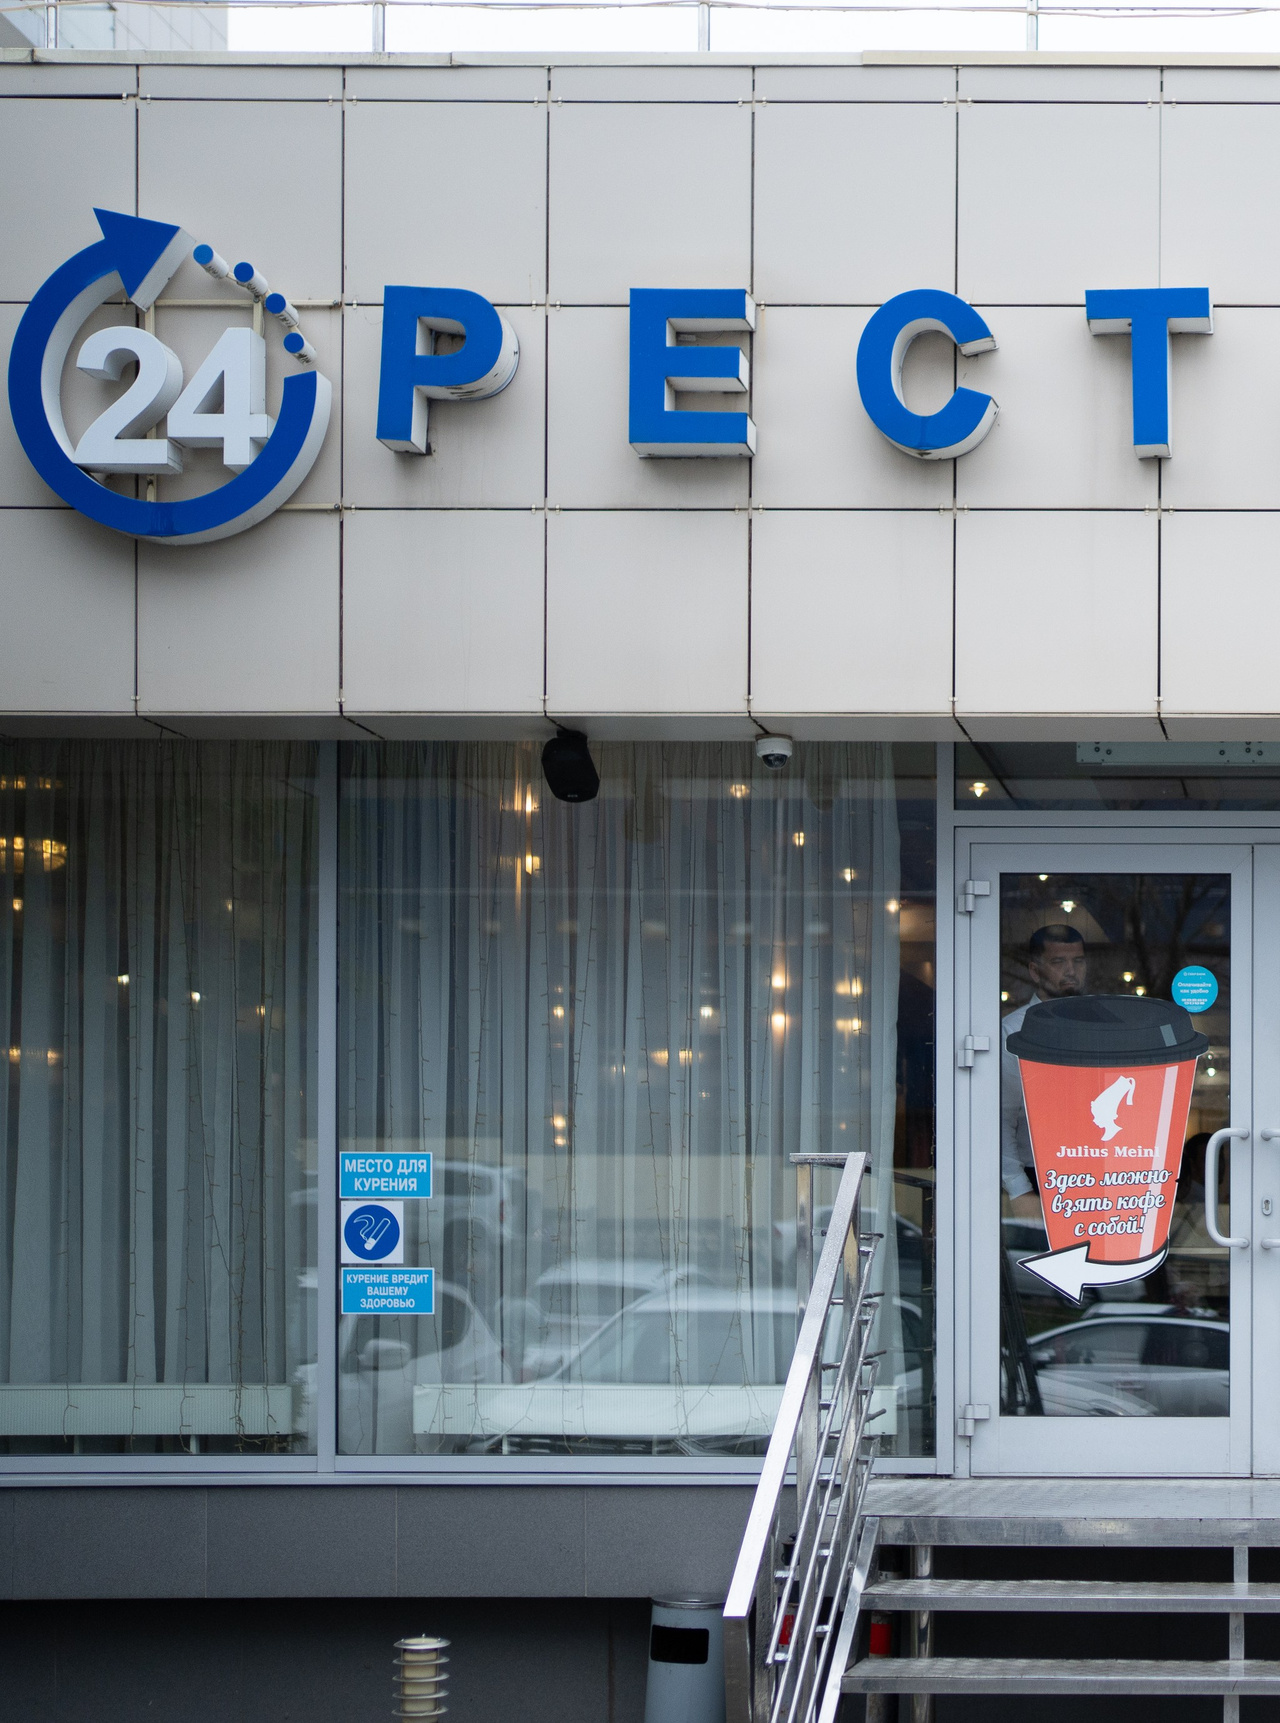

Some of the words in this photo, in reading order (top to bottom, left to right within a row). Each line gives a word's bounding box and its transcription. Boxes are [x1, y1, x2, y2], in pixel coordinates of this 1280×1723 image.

[74, 326, 272, 470] 24
[1056, 1145, 1109, 1158] Julius
[1114, 1145, 1160, 1158] Meinl
[345, 1159, 393, 1173] МЕСТО
[397, 1159, 427, 1175] ДЛЯ
[354, 1177, 417, 1192] КУРЕНИЯ
[1044, 1169, 1096, 1194] Здесь
[1099, 1169, 1172, 1186] можно
[1051, 1194, 1113, 1218] взять
[1116, 1190, 1166, 1214] кофе
[1074, 1222, 1086, 1237] с
[1087, 1215, 1146, 1236] собой!
[346, 1274, 389, 1284] КУРЕНИЕ
[392, 1274, 429, 1286] ВРЕДИТ
[367, 1286, 409, 1296] ВАШЕМУ
[360, 1298, 415, 1309] ЗДОРОВЬЮ
